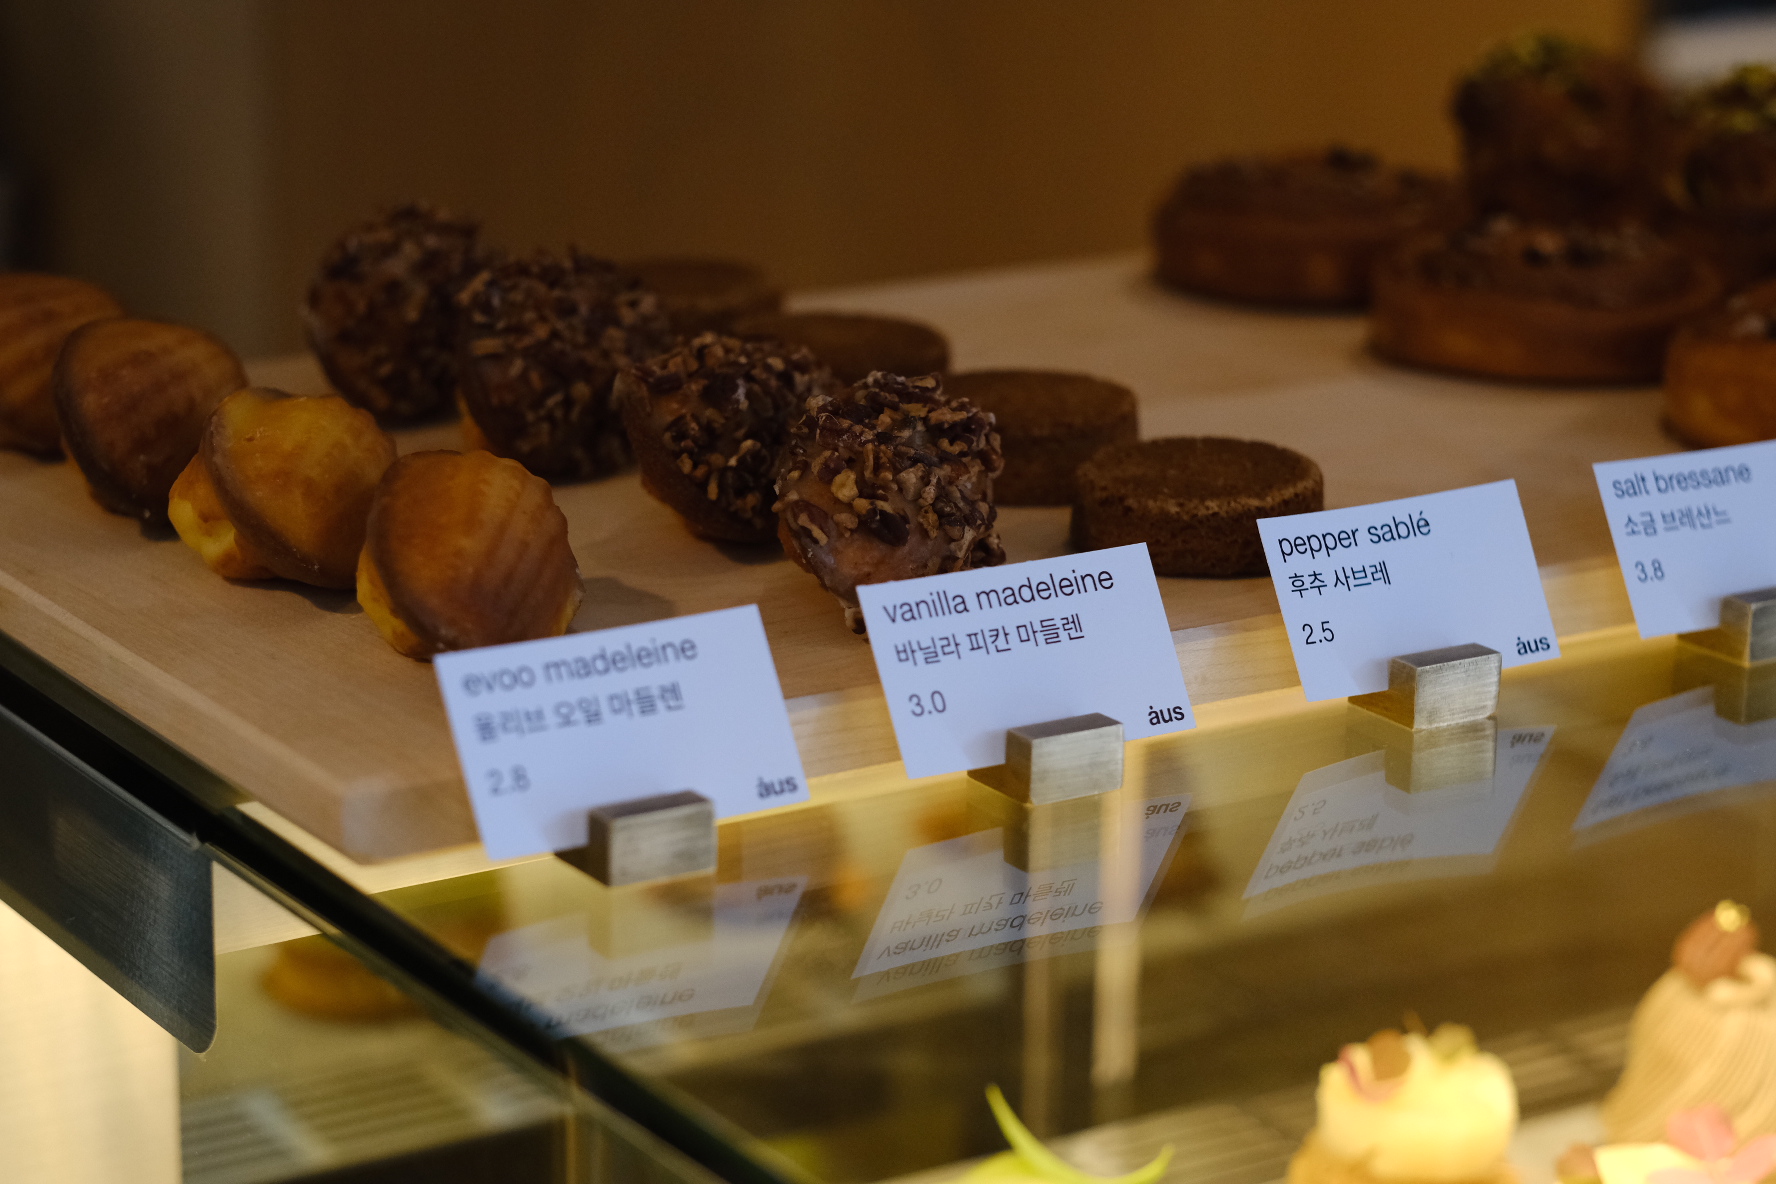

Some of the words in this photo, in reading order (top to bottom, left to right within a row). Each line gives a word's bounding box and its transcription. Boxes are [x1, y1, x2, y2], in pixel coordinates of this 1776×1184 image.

[1612, 471, 1650, 499] salt
[1652, 463, 1753, 495] bressane
[1278, 528, 1359, 563] pepper
[1367, 511, 1431, 544] sablé
[1624, 510, 1658, 537] 소금
[1660, 503, 1732, 532] 브레산느
[1288, 571, 1328, 598] 후추
[1334, 560, 1391, 592] 사브레
[1635, 558, 1665, 583] 3.8
[883, 590, 969, 624] vanilla
[976, 569, 1114, 610] madeleine
[895, 634, 961, 666] 바닐라
[967, 625, 1012, 656] 피칸
[1016, 613, 1085, 647] 마들렌
[1302, 620, 1335, 645] 2.5
[461, 665, 535, 697] evoo
[543, 636, 698, 685] madeleine
[473, 704, 548, 742] 올리브
[552, 697, 604, 729] 오일
[608, 681, 685, 719] 마들렌
[907, 690, 947, 717] 3.0
[485, 764, 531, 796] 2.8
